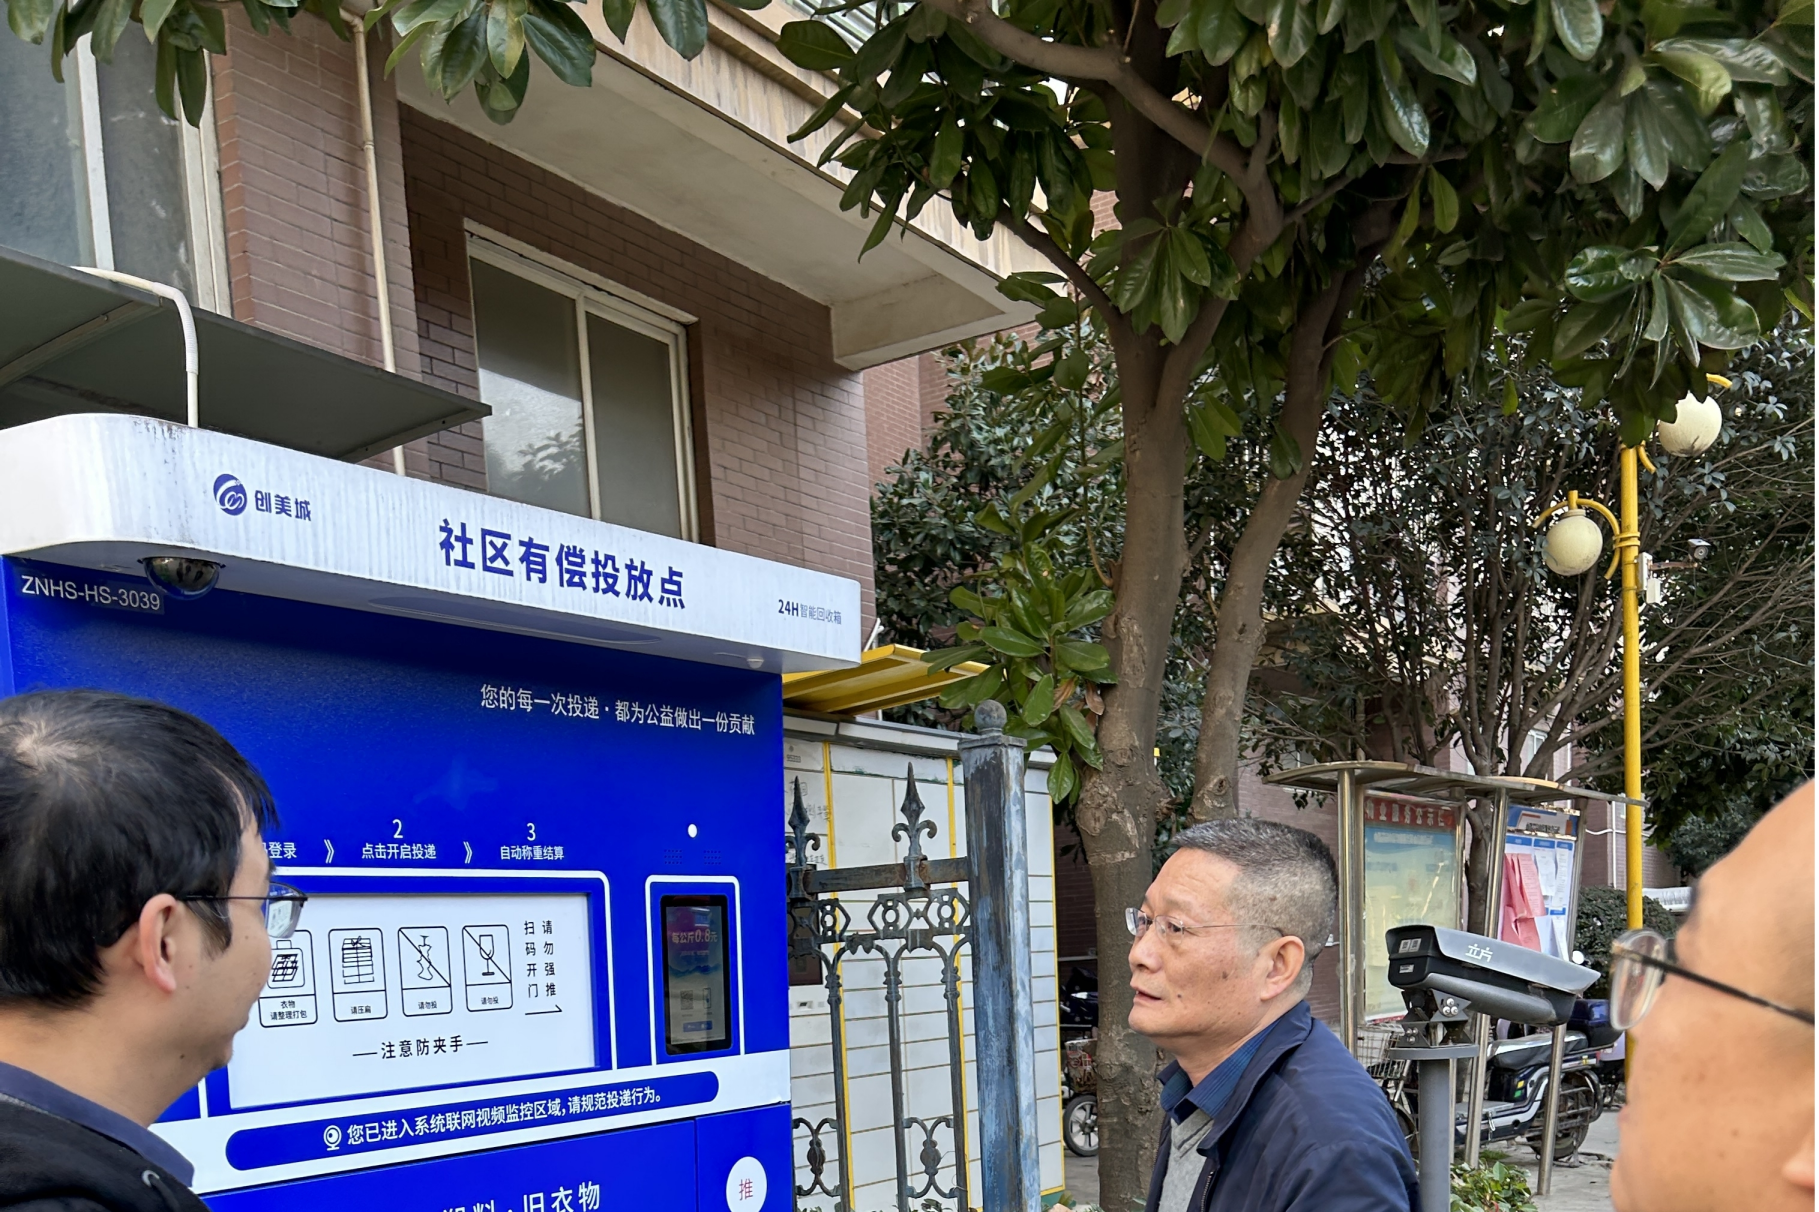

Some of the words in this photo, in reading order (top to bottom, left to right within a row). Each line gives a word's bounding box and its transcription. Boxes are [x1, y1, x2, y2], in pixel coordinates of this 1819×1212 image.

[254, 489, 312, 521] 创美城
[439, 518, 685, 609] 社区有偿投放点
[21, 575, 161, 610] ZNHS-HS-3039
[392, 819, 403, 839] 2
[527, 823, 536, 841] 3
[261, 841, 297, 860] 登录
[361, 843, 437, 860] 点击开启投递
[500, 845, 564, 861] 自动称重结算
[1465, 943, 1493, 963] 立方
[280, 1000, 295, 1009] 衣物
[351, 1005, 371, 1015] 请压扁
[270, 1010, 307, 1020] 请整理打包
[381, 1035, 463, 1059] 注意防夹手
[739, 1178, 753, 1201] 推
